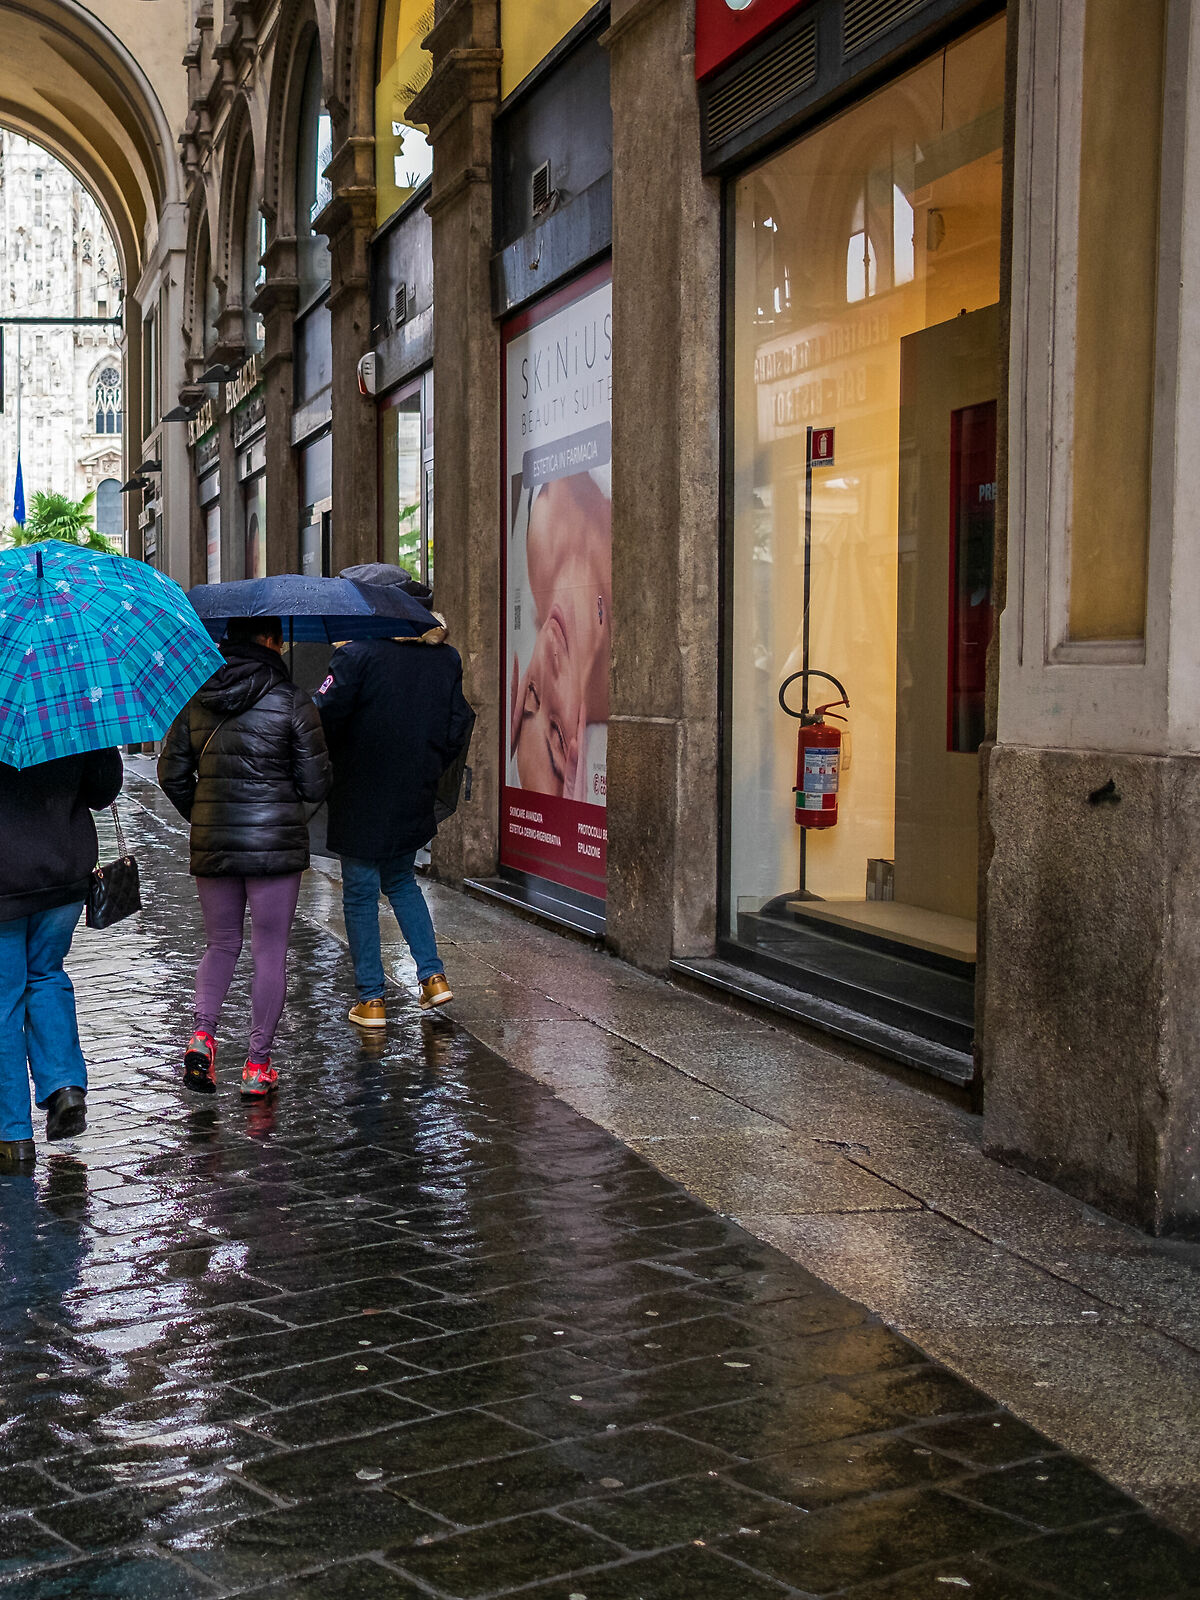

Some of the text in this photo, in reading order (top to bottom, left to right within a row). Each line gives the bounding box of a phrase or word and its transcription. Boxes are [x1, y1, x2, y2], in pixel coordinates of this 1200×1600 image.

[522, 375, 612, 436] BEAUTY SUITE
[533, 440, 598, 477] ESTETICA IN FARMACIA
[509, 806, 543, 823] SKINCARE AVANZATA
[509, 823, 561, 847] ESTETICA DERMO-RIGENERATIVA
[578, 823, 601, 839] PROTOCOLLI
[578, 842, 601, 859] EPILAZIONE
